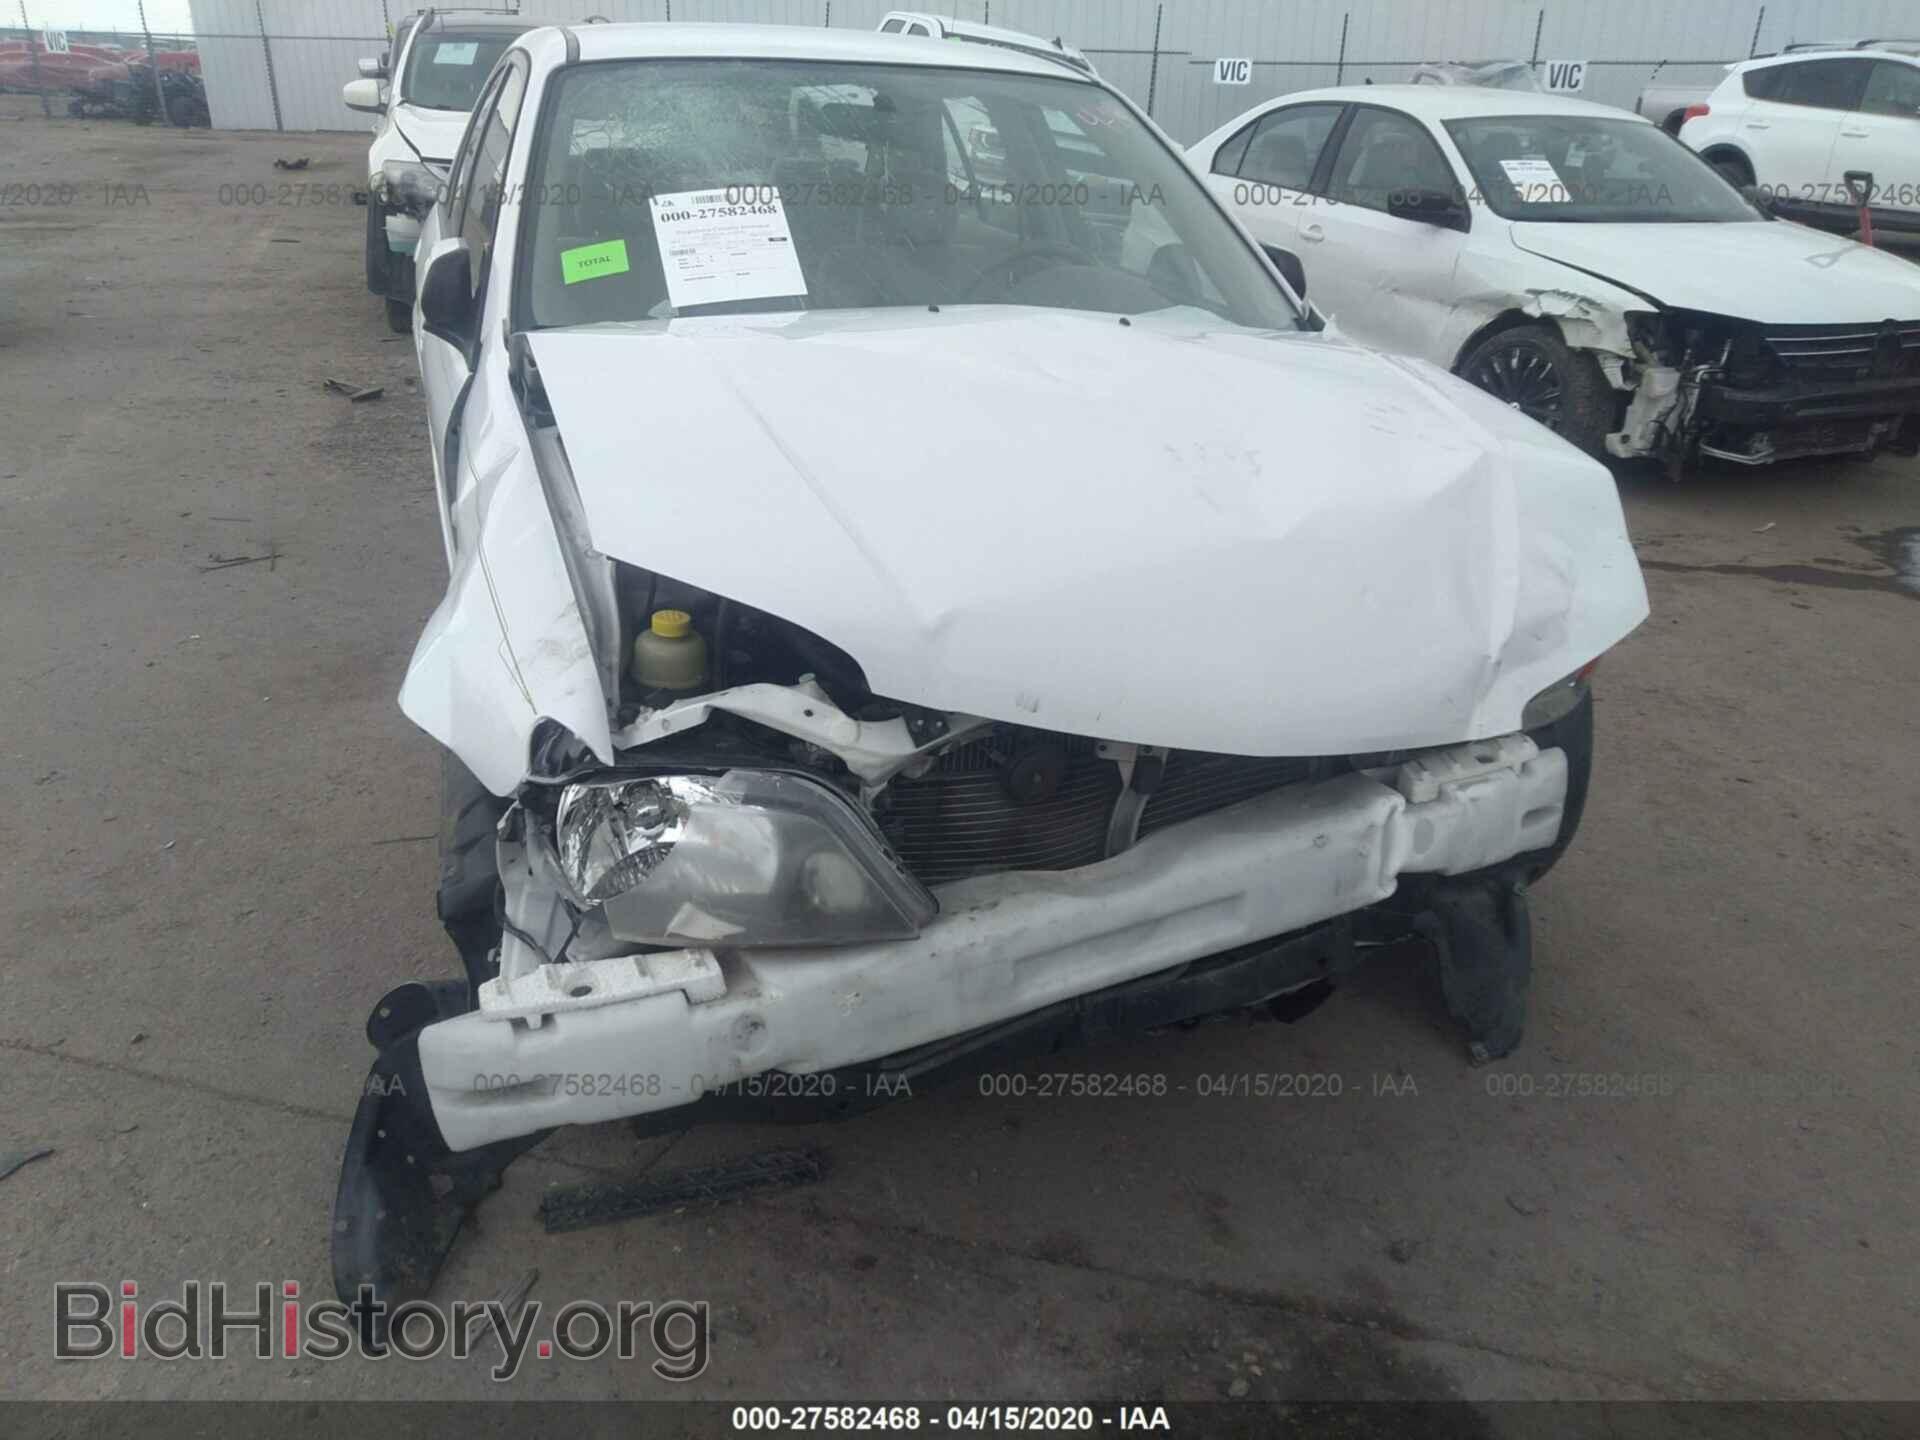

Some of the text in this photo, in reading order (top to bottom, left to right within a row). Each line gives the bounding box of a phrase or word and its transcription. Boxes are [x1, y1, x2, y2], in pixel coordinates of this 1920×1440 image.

[44, 31, 65, 51] VIC
[1220, 60, 1248, 82] VIC
[1550, 63, 1582, 89] VIC
[660, 205, 778, 222] 000-27582468
[578, 255, 611, 268] TOTAL
